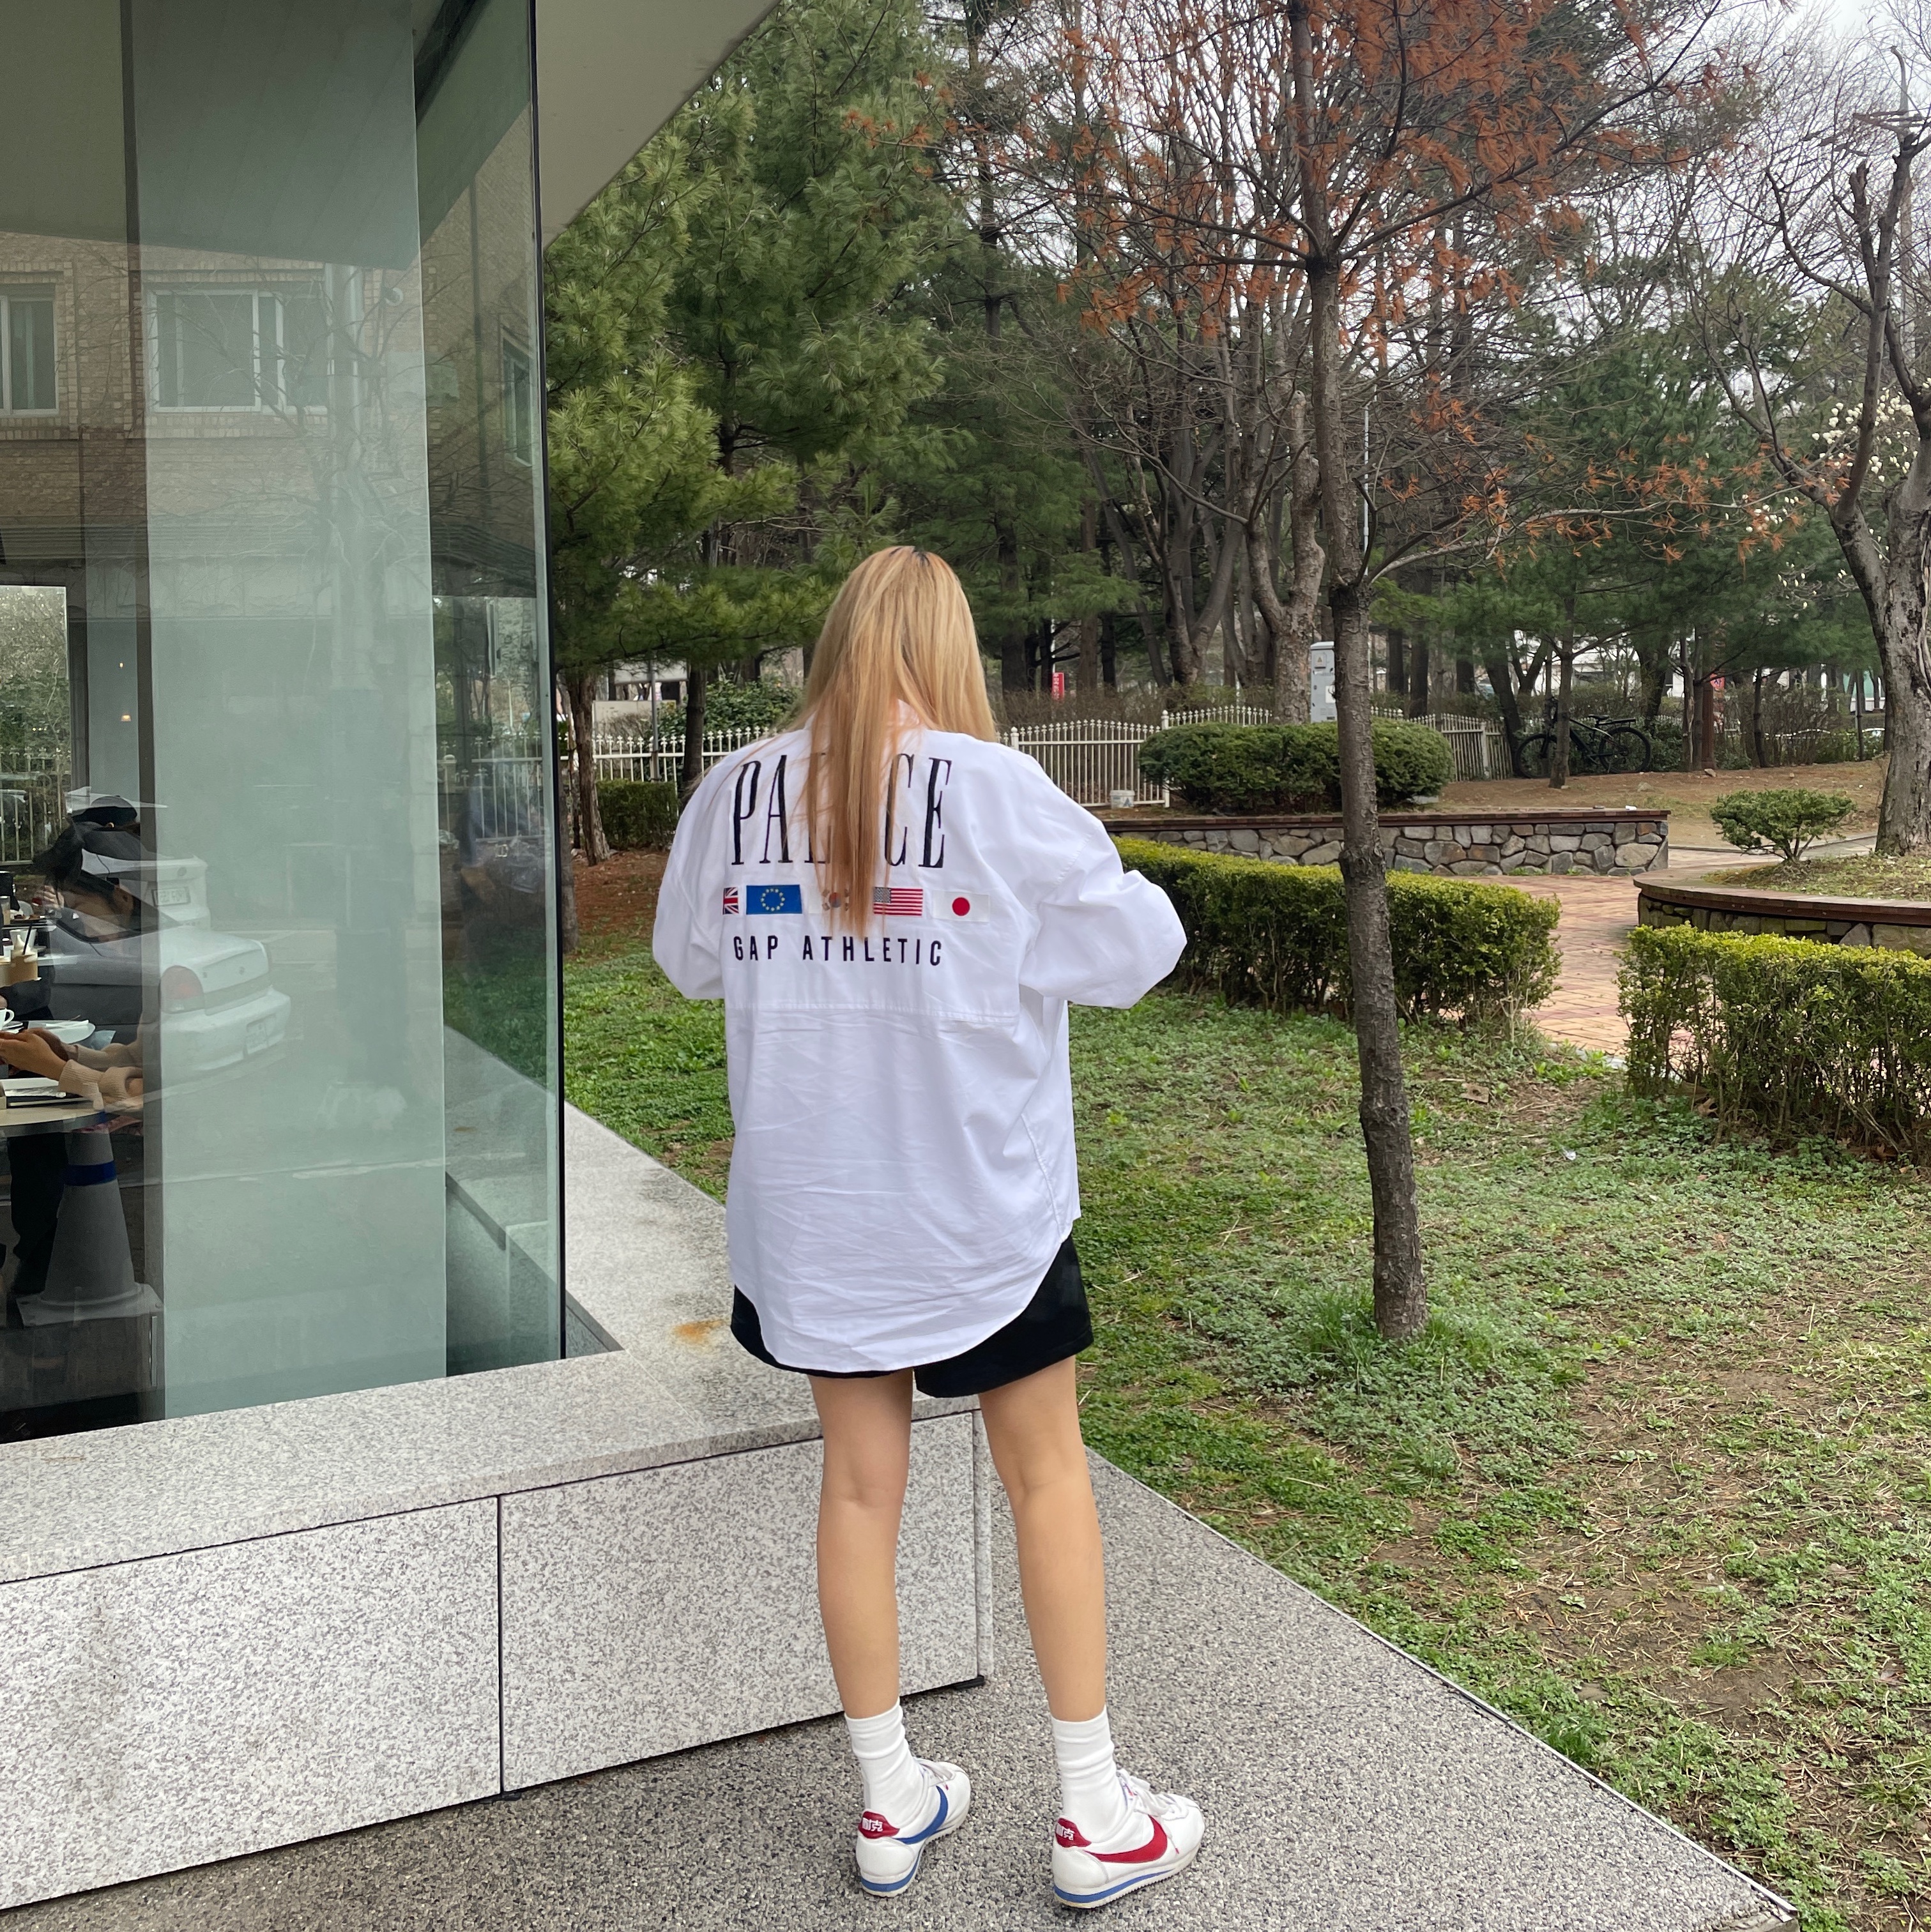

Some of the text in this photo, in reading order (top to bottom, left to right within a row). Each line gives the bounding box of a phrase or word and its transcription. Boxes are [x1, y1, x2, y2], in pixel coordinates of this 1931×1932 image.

[731, 753, 952, 869] PACE
[733, 934, 942, 966] GAP ATHLETIC
[1056, 1823, 1075, 1841] 克
